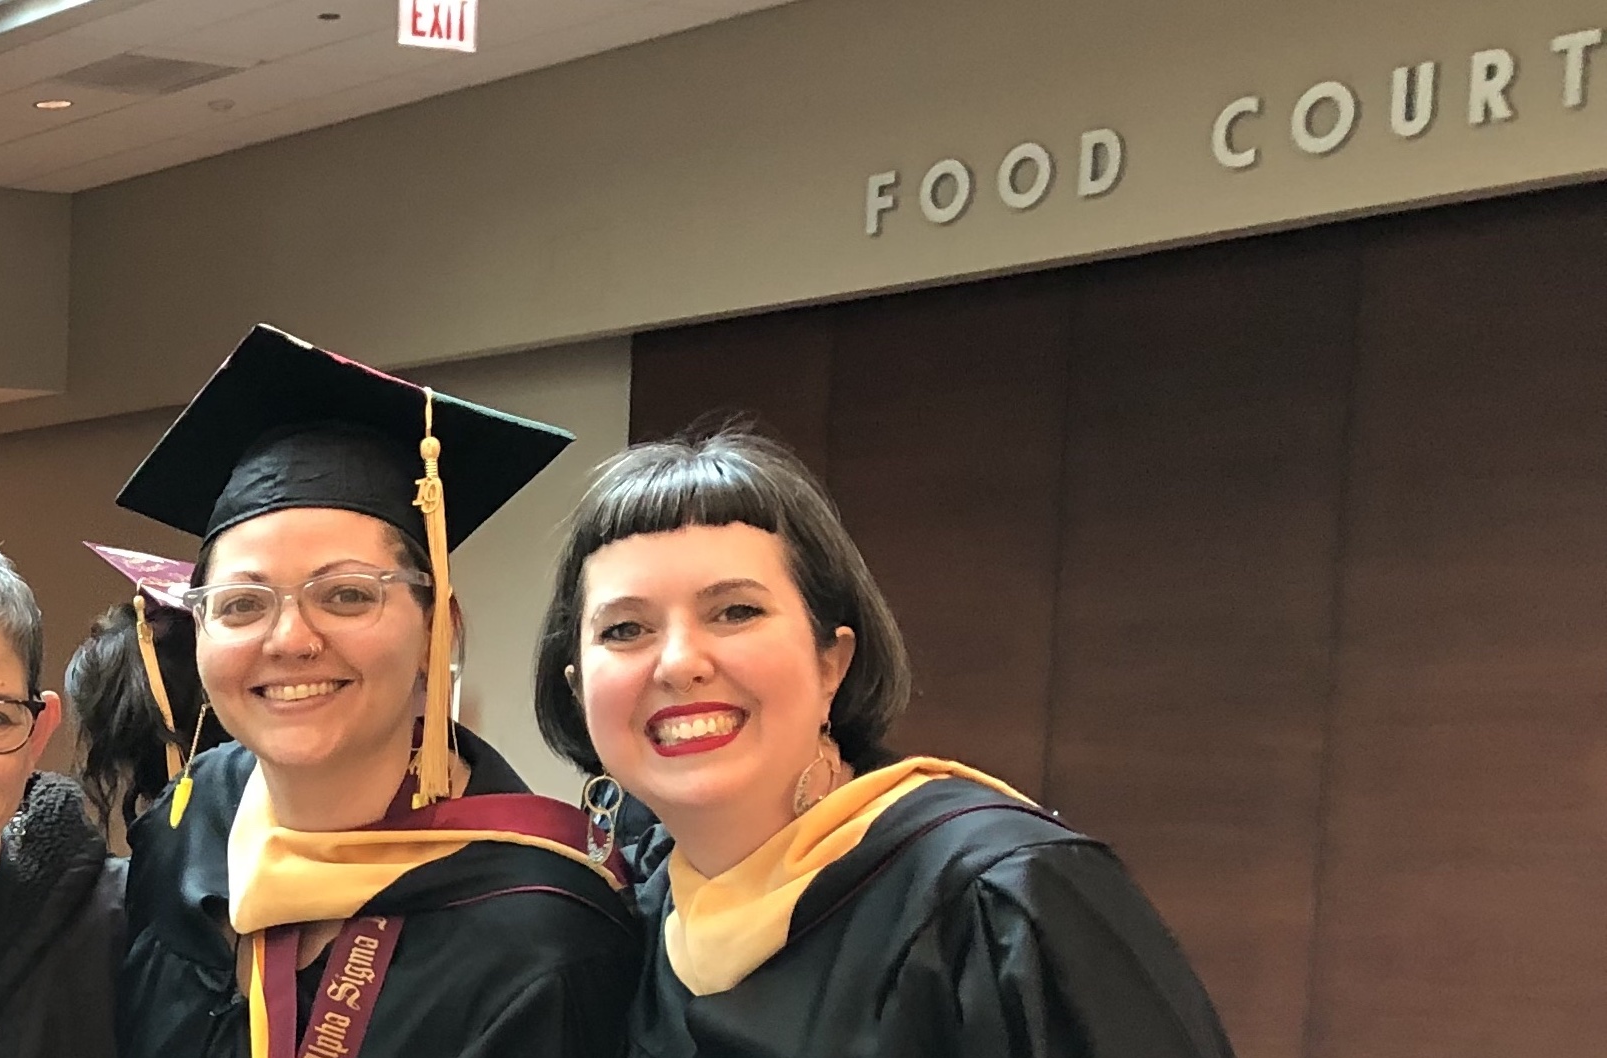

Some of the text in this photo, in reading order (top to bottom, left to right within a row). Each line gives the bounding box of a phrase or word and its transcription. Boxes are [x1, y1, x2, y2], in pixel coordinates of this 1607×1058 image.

[411, 0, 468, 42] EXIT
[865, 28, 1603, 236] FOOD COURT
[326, 935, 379, 1011] Sigma
